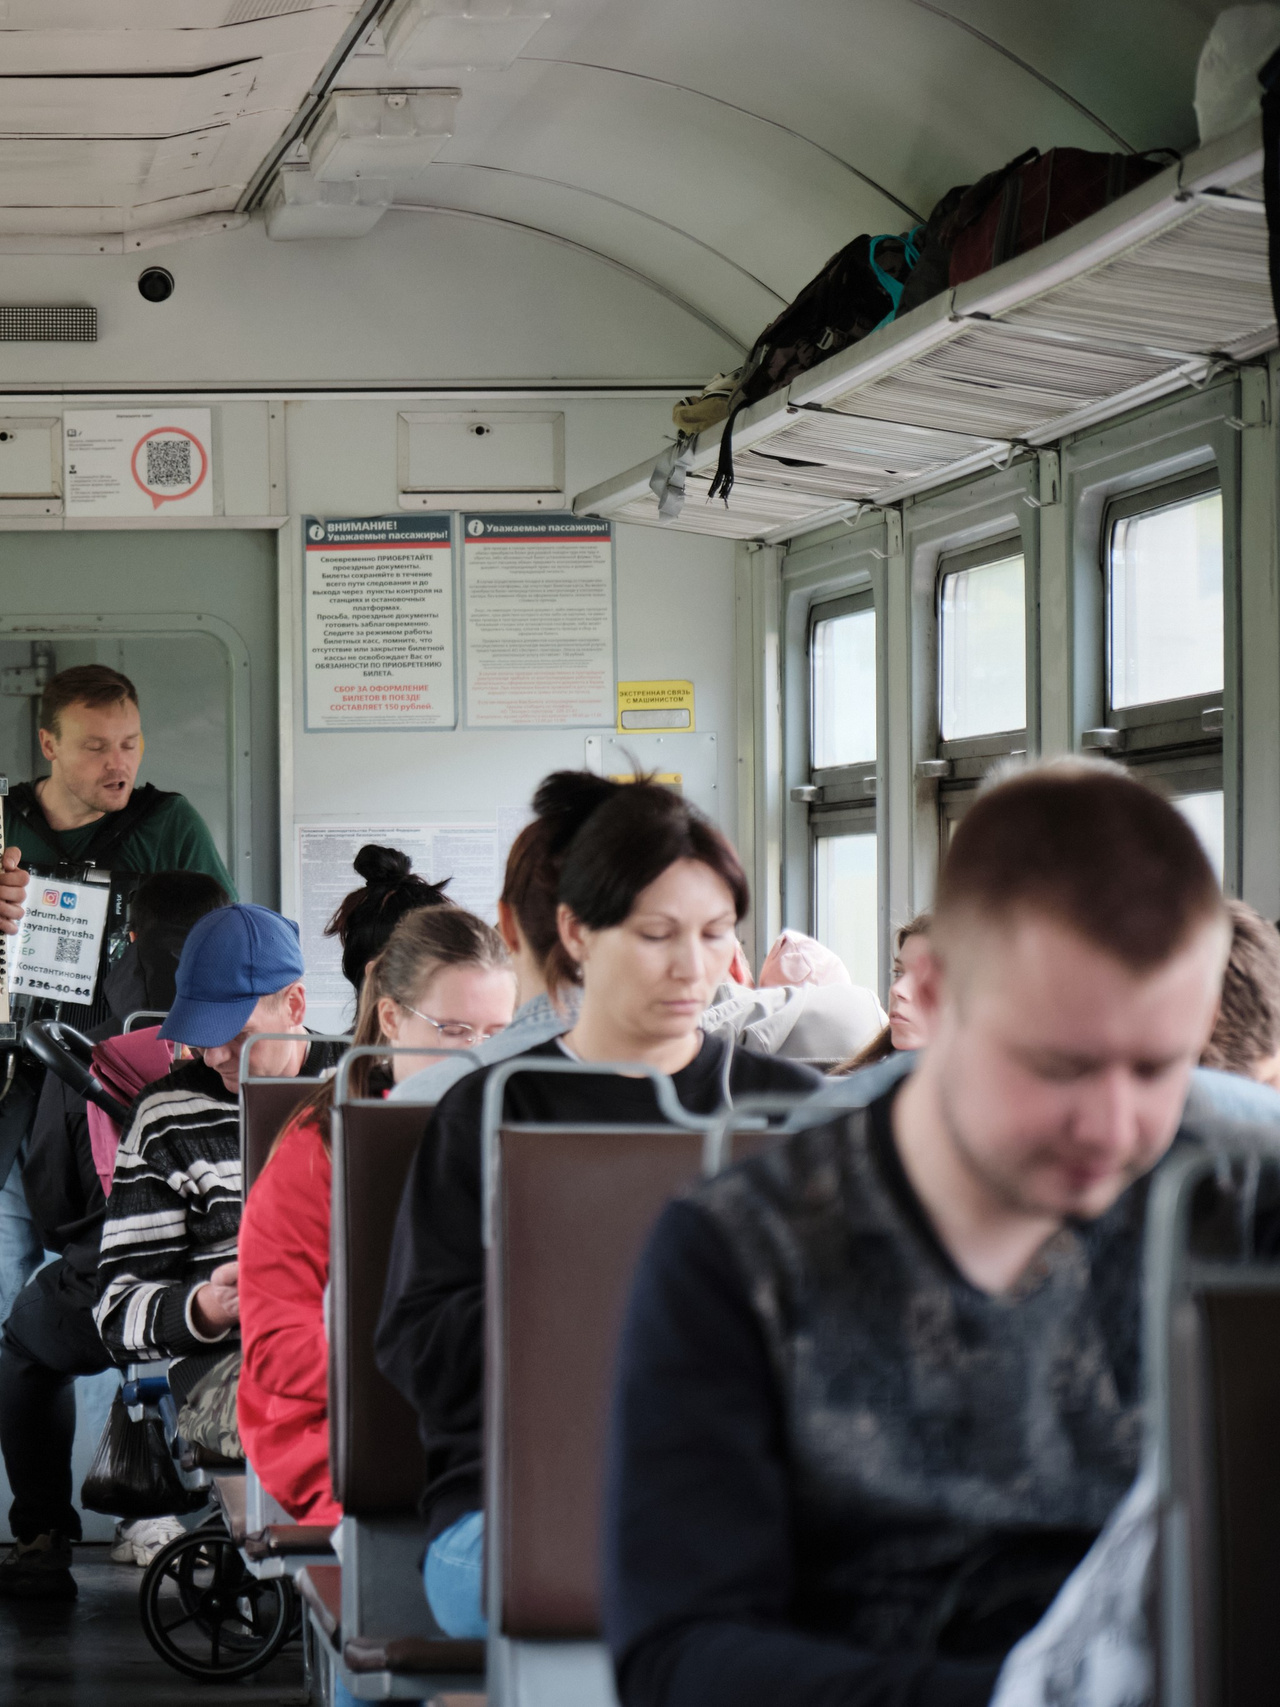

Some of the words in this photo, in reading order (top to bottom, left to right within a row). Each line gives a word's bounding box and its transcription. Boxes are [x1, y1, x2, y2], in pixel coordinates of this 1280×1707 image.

[327, 521, 397, 532] ВНИМАНИЕ!
[487, 524, 547, 533] Уважаемые
[549, 523, 608, 532] пассажиры!
[327, 532, 387, 541] Уважаемые
[388, 531, 447, 540] пассажиры!
[401, 703, 434, 711] рублей.
[24, 922, 94, 939] ayanistayusha
